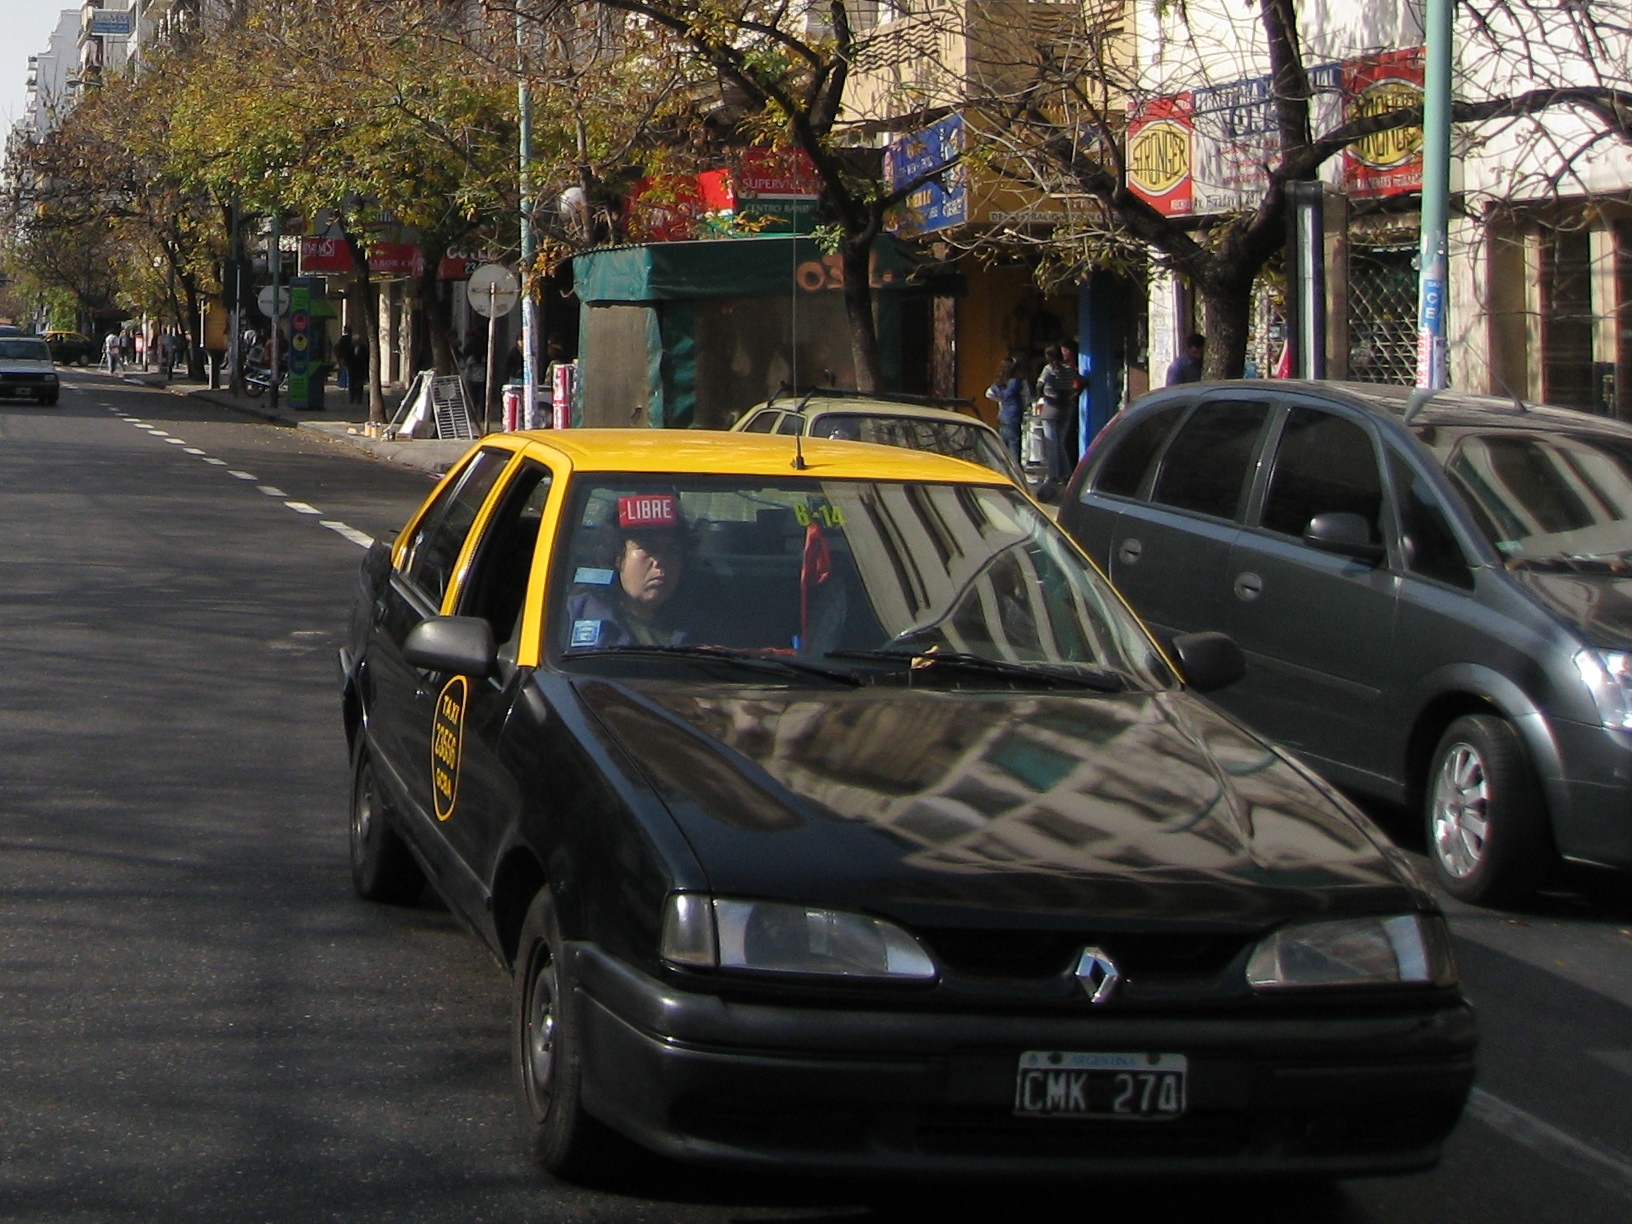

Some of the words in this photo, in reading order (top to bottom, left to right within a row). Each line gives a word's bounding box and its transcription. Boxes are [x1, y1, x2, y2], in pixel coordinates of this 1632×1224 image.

[1133, 129, 1188, 186] STRONGER
[626, 498, 672, 522] LIBRE
[442, 694, 460, 726] TAXI
[1023, 1072, 1088, 1112] CMK
[1113, 1073, 1178, 1113] 270
